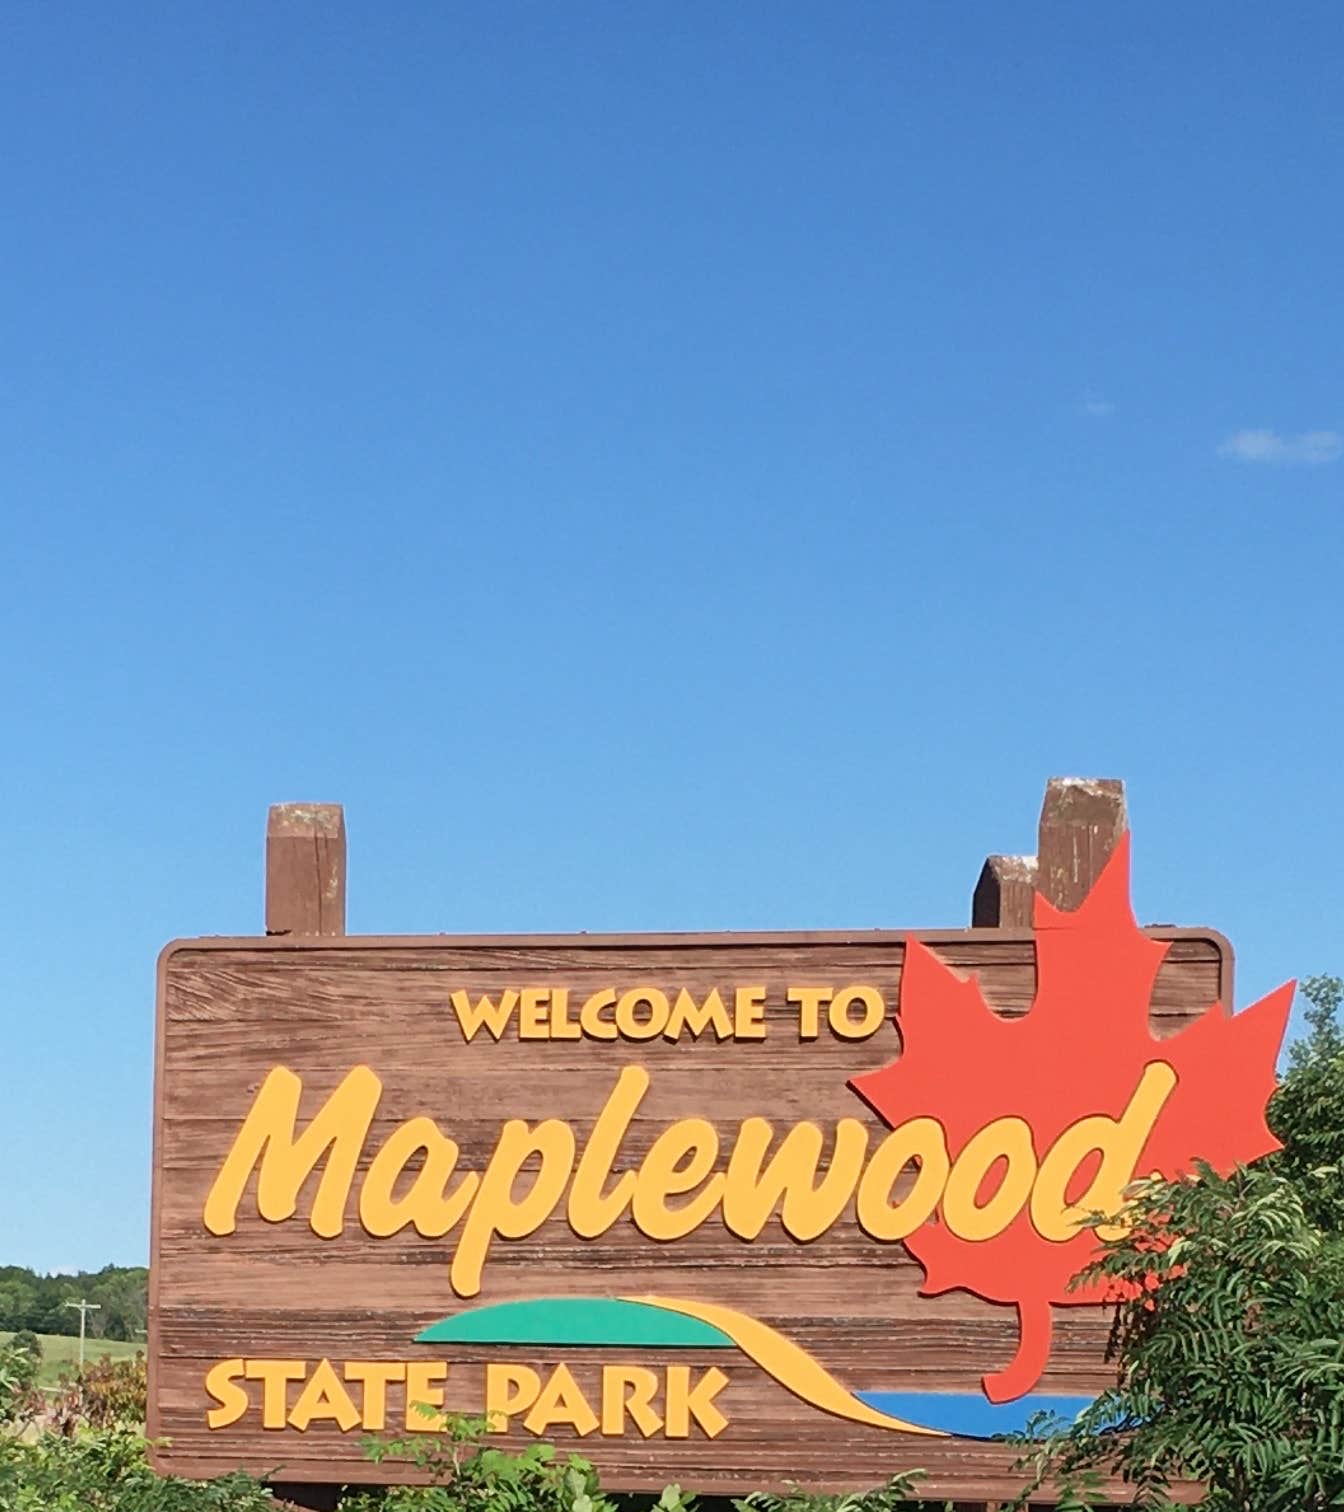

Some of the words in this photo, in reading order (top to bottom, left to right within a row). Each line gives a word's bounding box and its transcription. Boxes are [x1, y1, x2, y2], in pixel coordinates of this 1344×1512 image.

[450, 984, 769, 1041] WELCOME
[787, 984, 887, 1040] TO
[202, 1061, 1178, 1297] Maplewood
[205, 1357, 449, 1433] STATE
[486, 1361, 731, 1439] PARK
